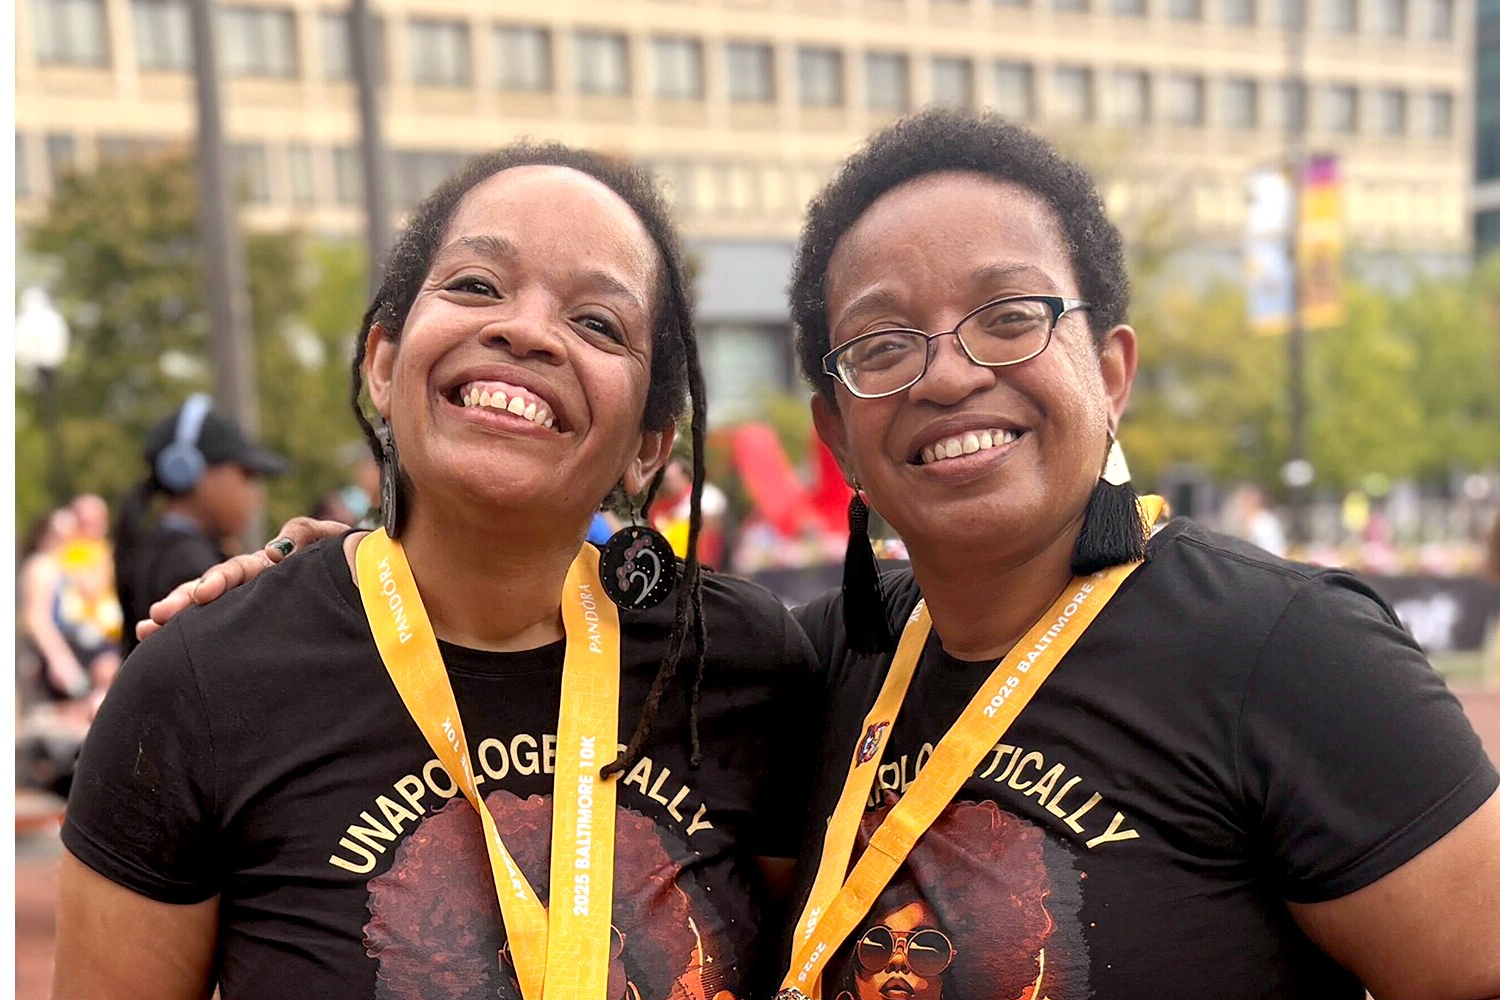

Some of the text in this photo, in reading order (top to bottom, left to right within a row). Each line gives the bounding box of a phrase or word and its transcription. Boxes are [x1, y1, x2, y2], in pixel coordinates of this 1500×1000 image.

[376, 555, 413, 645] PANDORA
[578, 584, 602, 654] PANDORA
[984, 583, 1095, 718] 2025 BALTIMORE
[329, 733, 714, 876] UNAPOOGEALLY
[573, 736, 596, 917] 2025 BALTIMORE 10K
